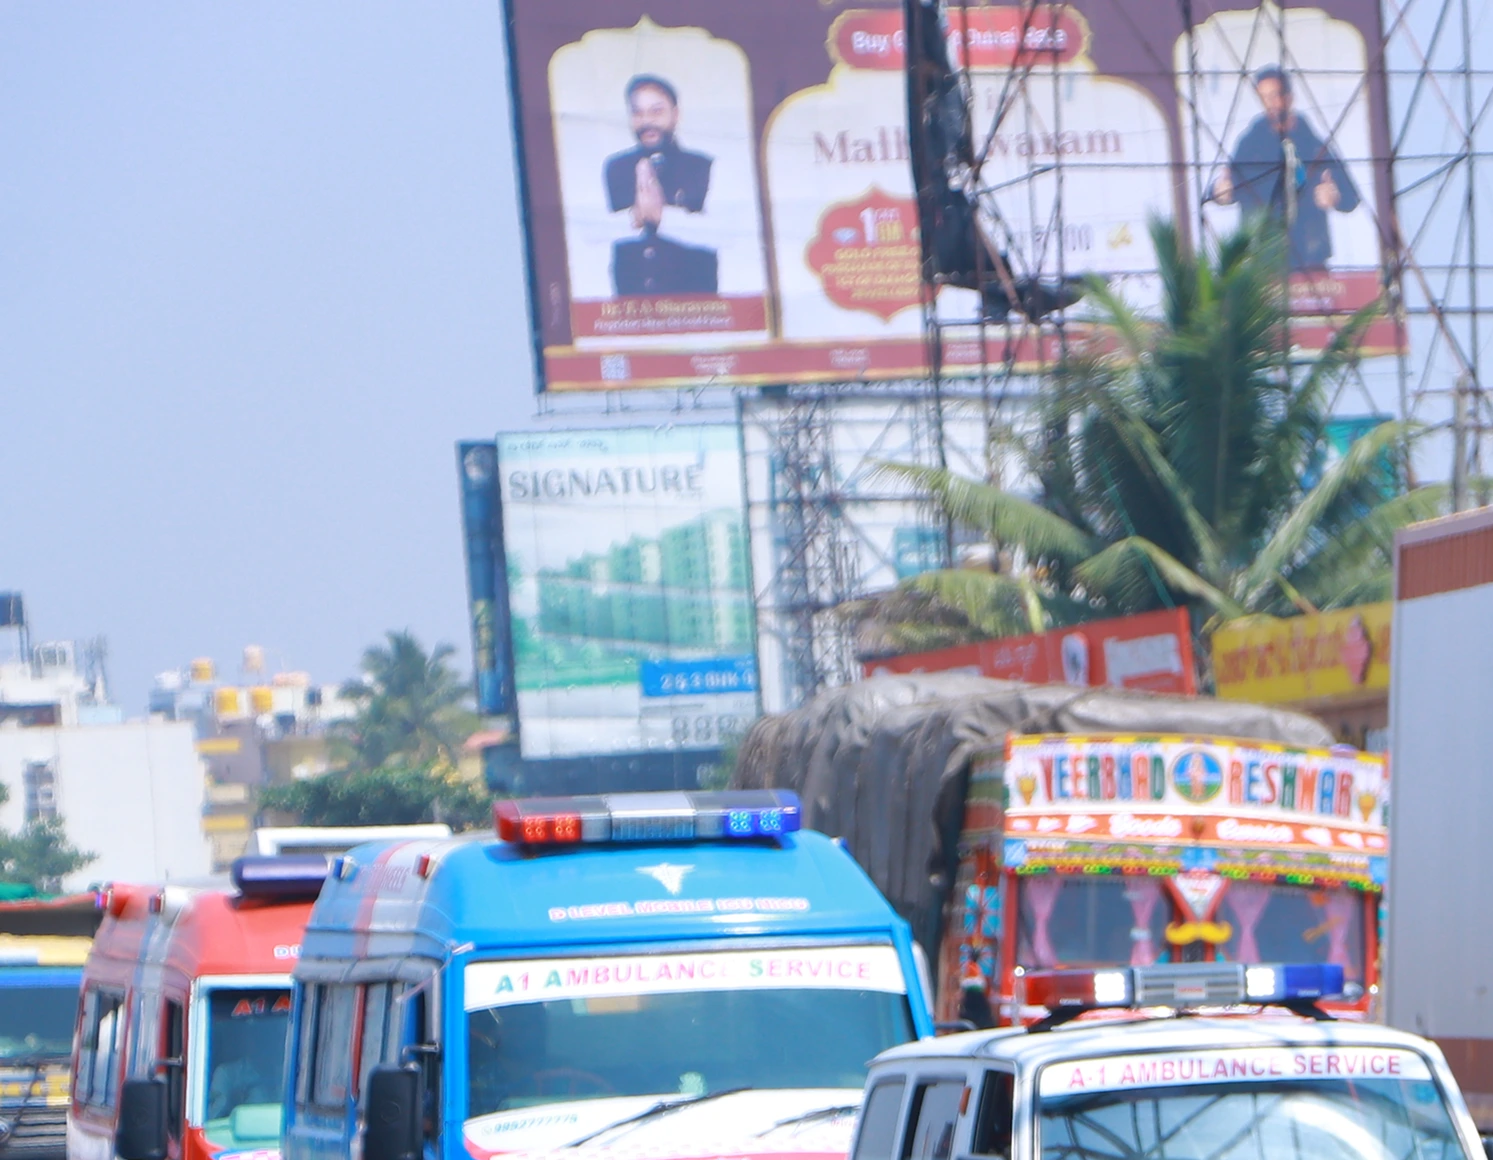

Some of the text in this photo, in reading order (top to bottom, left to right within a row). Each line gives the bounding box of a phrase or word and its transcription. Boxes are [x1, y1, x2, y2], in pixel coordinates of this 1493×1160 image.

[508, 464, 704, 500] SIGNATURE
[1228, 759, 1354, 818] RESHWAR
[495, 971, 530, 994] A1
[748, 957, 872, 979] SERVICE
[1121, 1055, 1282, 1085] AMBULANCE
[1293, 1054, 1402, 1075] SERVICE
